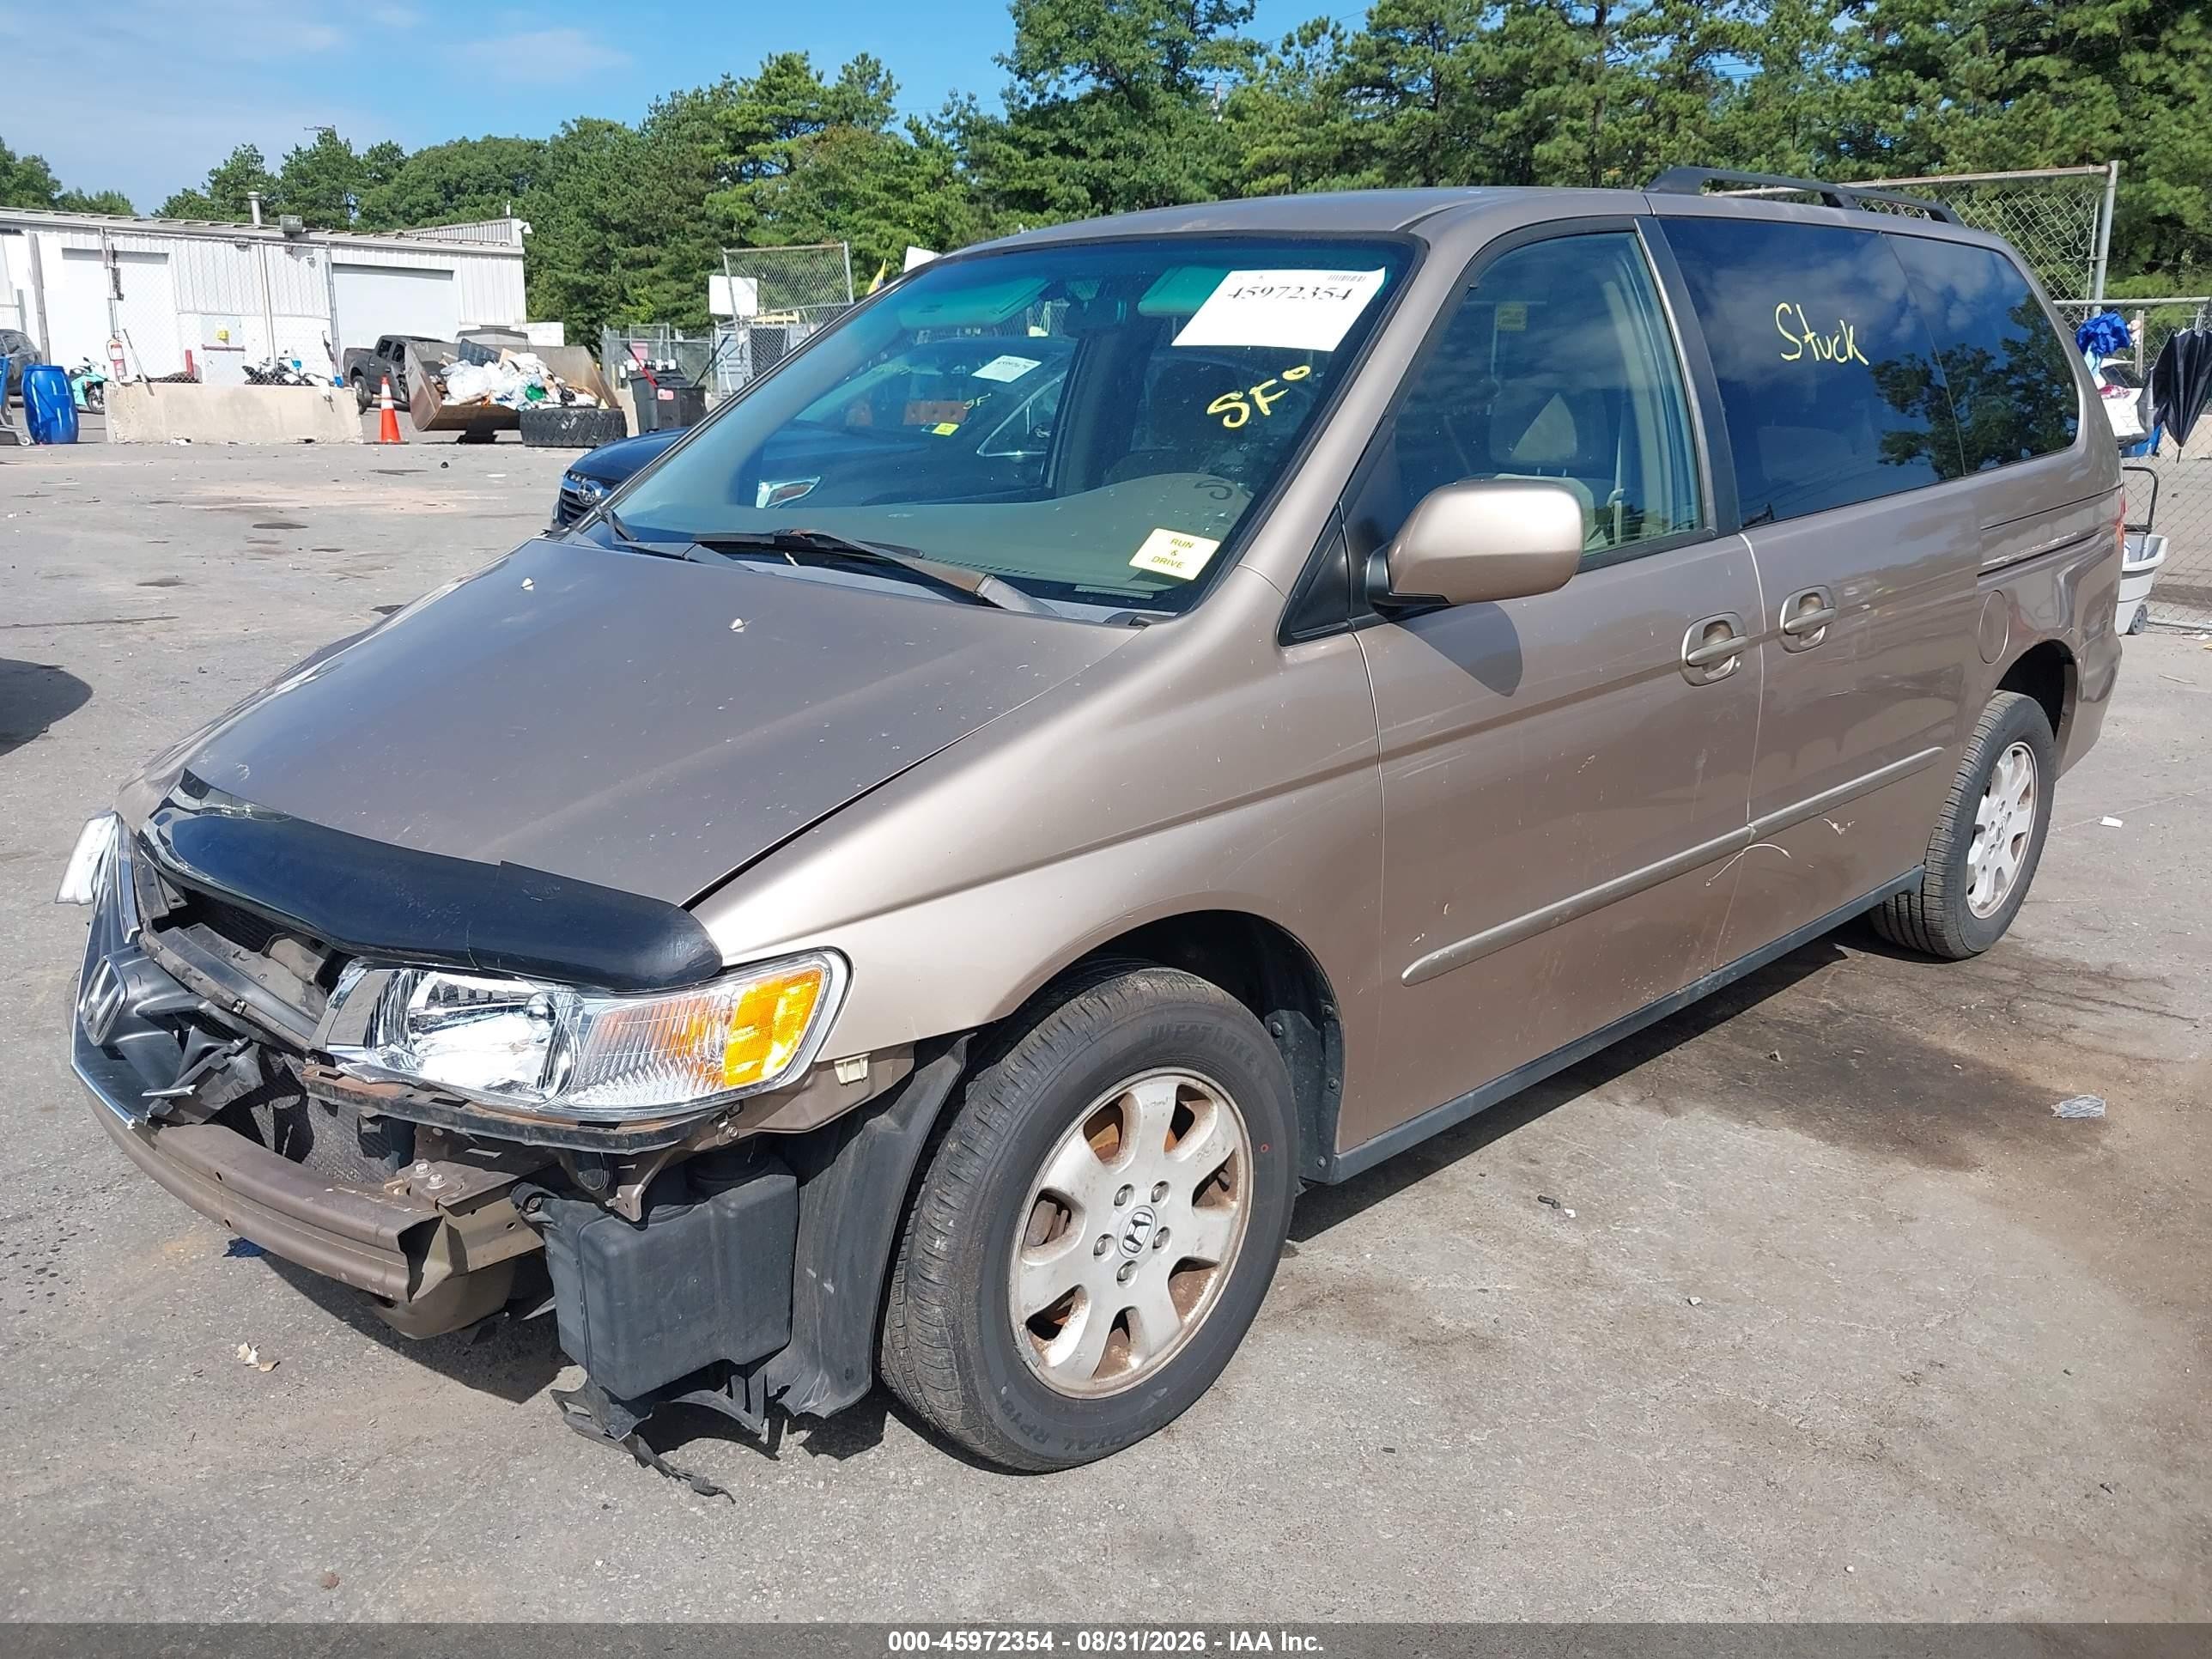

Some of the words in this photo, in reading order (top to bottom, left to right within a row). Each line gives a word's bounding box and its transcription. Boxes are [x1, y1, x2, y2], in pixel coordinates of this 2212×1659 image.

[1227, 286, 1353, 301] 45972354
[1775, 302, 1869, 366] Stuck
[1170, 538, 1195, 550] RUN
[1151, 555, 1186, 569] DRIVE
